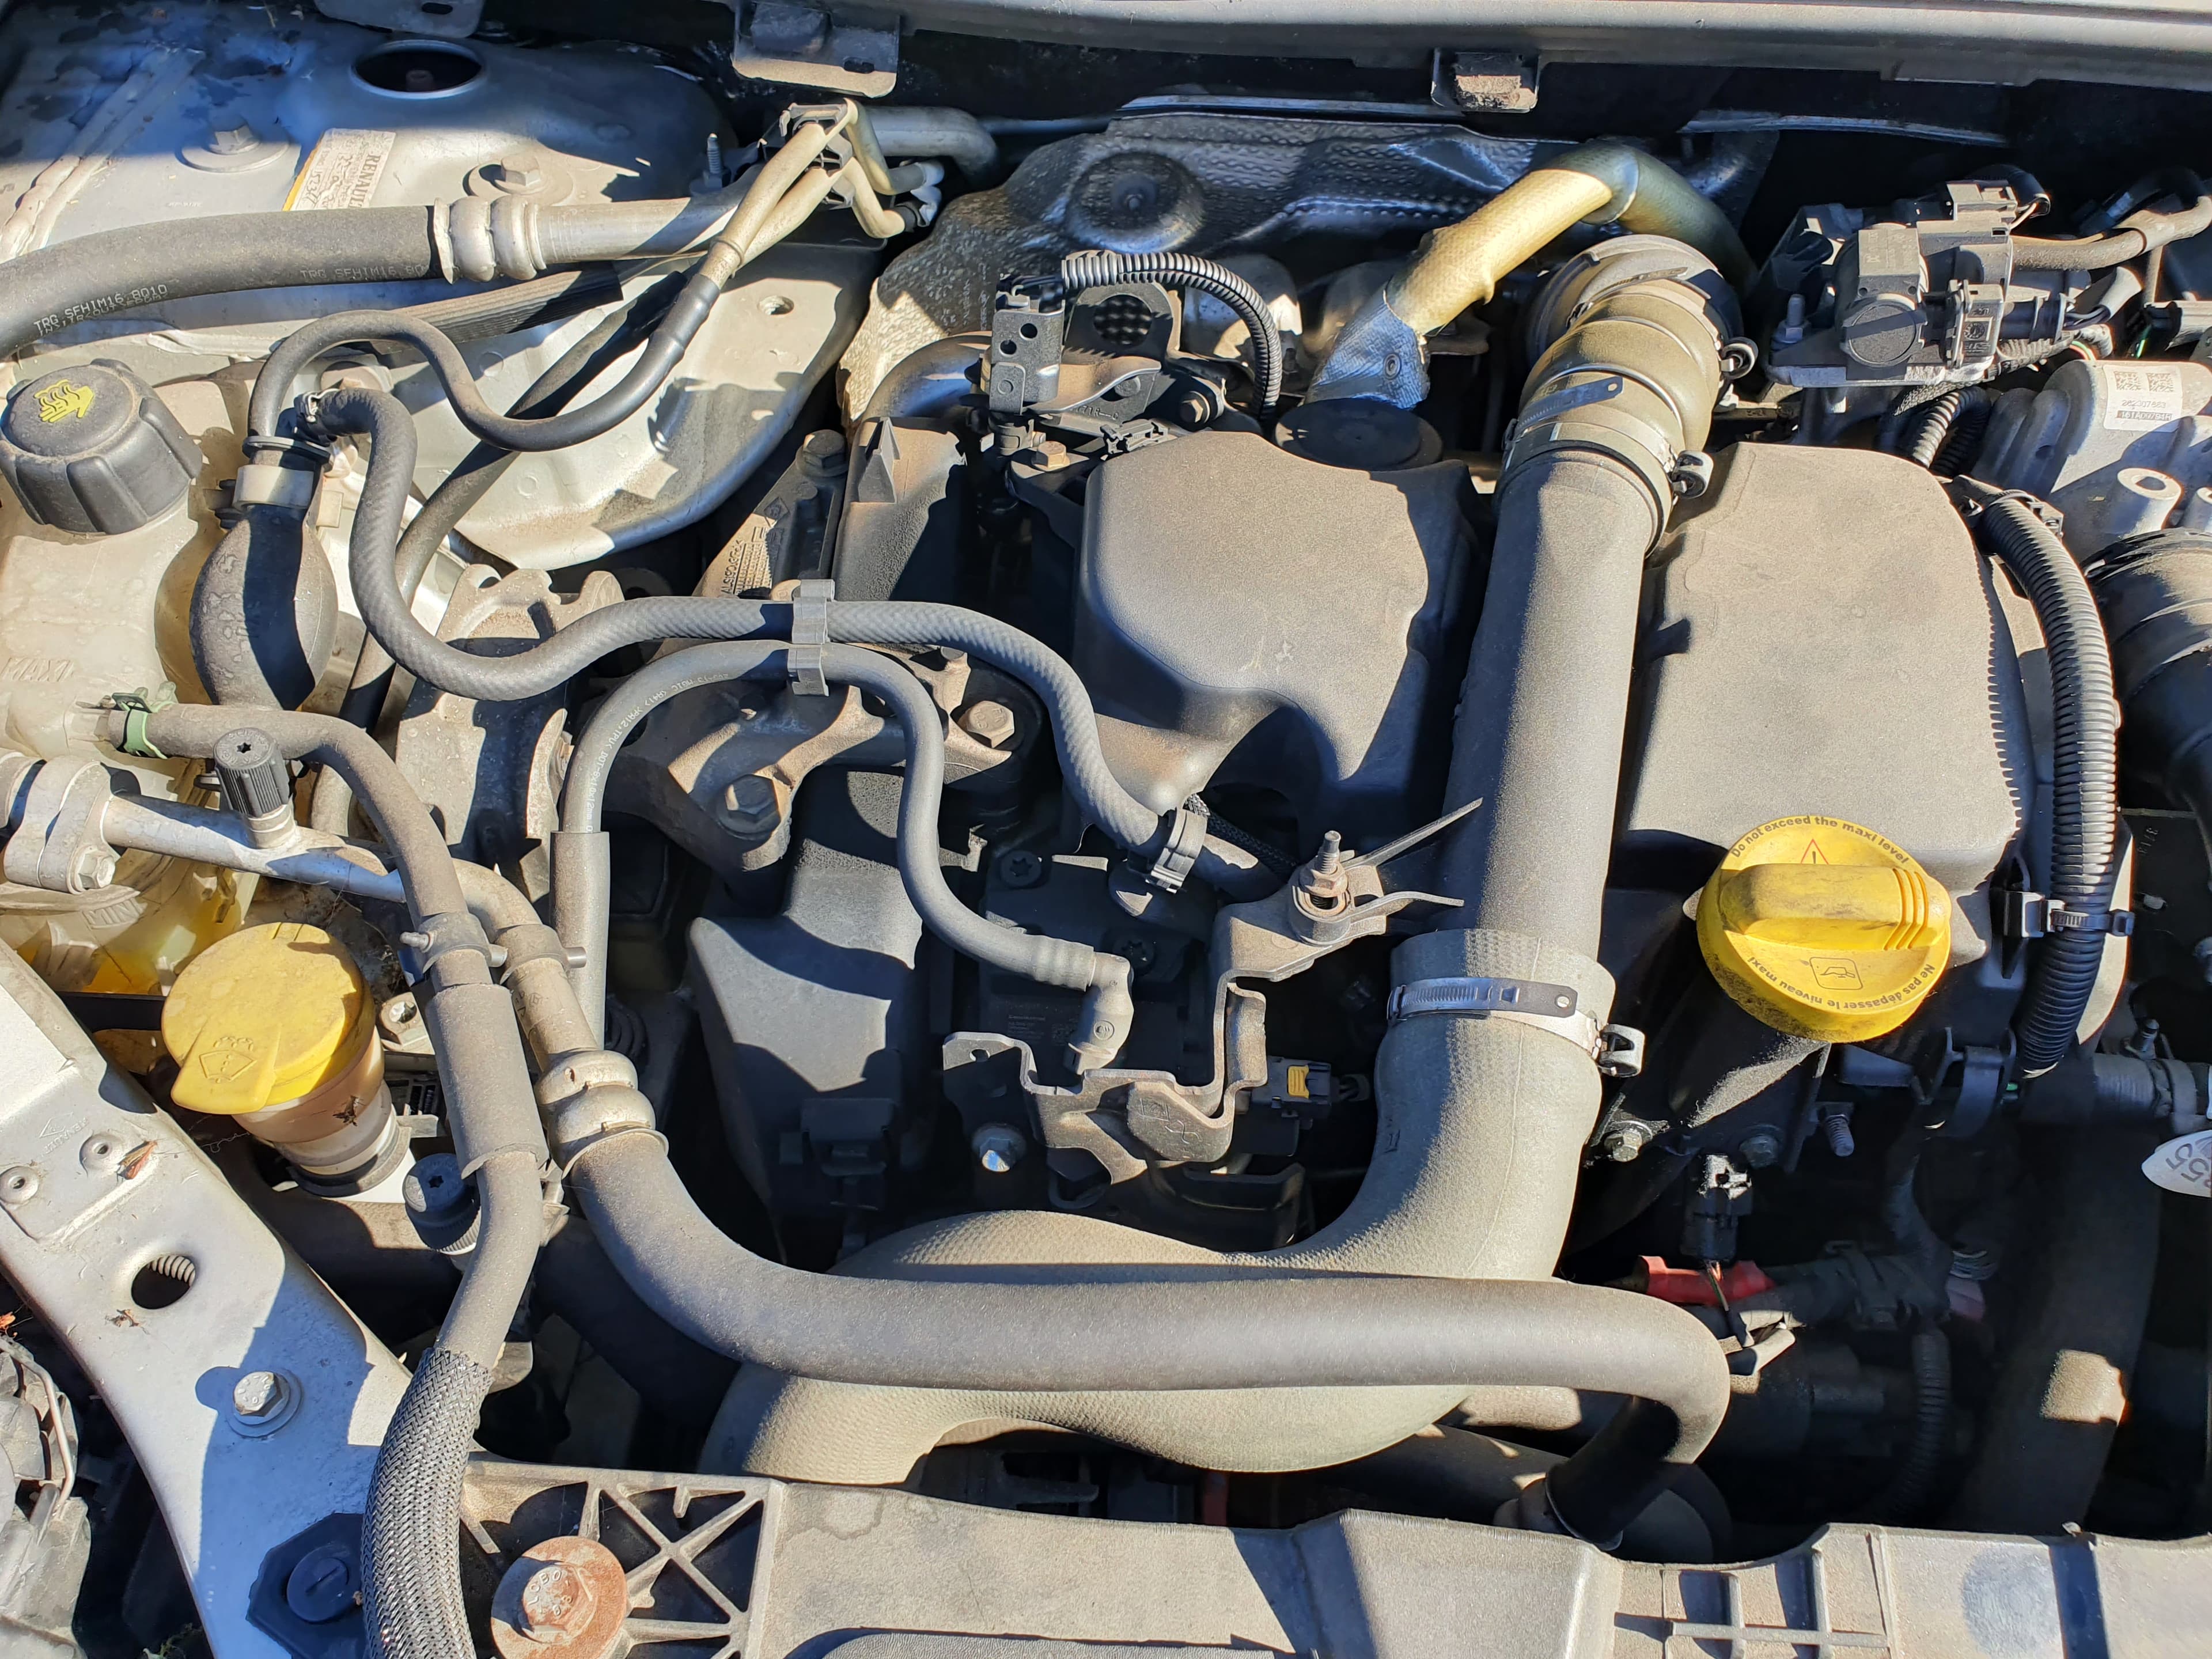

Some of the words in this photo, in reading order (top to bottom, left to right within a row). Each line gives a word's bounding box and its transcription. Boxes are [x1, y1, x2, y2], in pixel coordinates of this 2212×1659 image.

[33, 314, 59, 331] TRG
[1730, 842, 1746, 858] Do
[1745, 827, 1764, 845] not
[1764, 815, 1812, 832] exceed
[1815, 816, 1838, 828] the
[1842, 822, 1877, 842] maxi
[1878, 839, 1910, 865] level
[1747, 956, 1778, 983] maxi
[1920, 963, 1936, 979] Ne
[1779, 980, 1823, 1005] niveau
[1902, 976, 1922, 995] pas
[1826, 999, 1840, 1010] le
[1843, 991, 1902, 1010] dépasser
